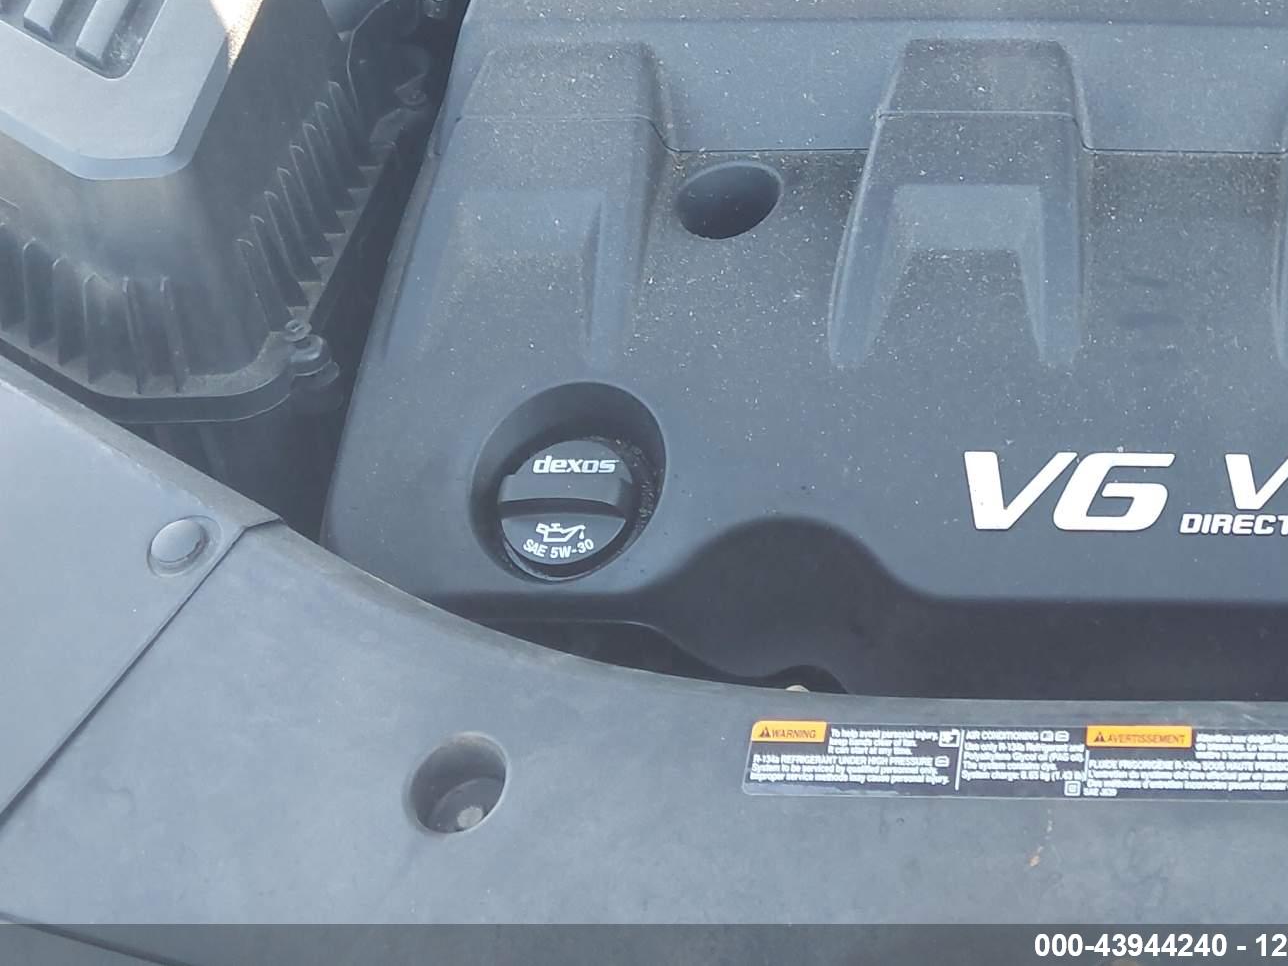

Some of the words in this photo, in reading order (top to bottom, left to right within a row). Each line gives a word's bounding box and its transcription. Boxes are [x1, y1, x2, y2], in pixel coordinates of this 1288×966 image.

[533, 455, 617, 474] dexos
[963, 451, 1176, 532] V6
[523, 539, 548, 559] SAE
[550, 539, 595, 559] 5W-30
[772, 729, 818, 739] WARNING
[1107, 733, 1186, 744] AVERTISSEMENT
